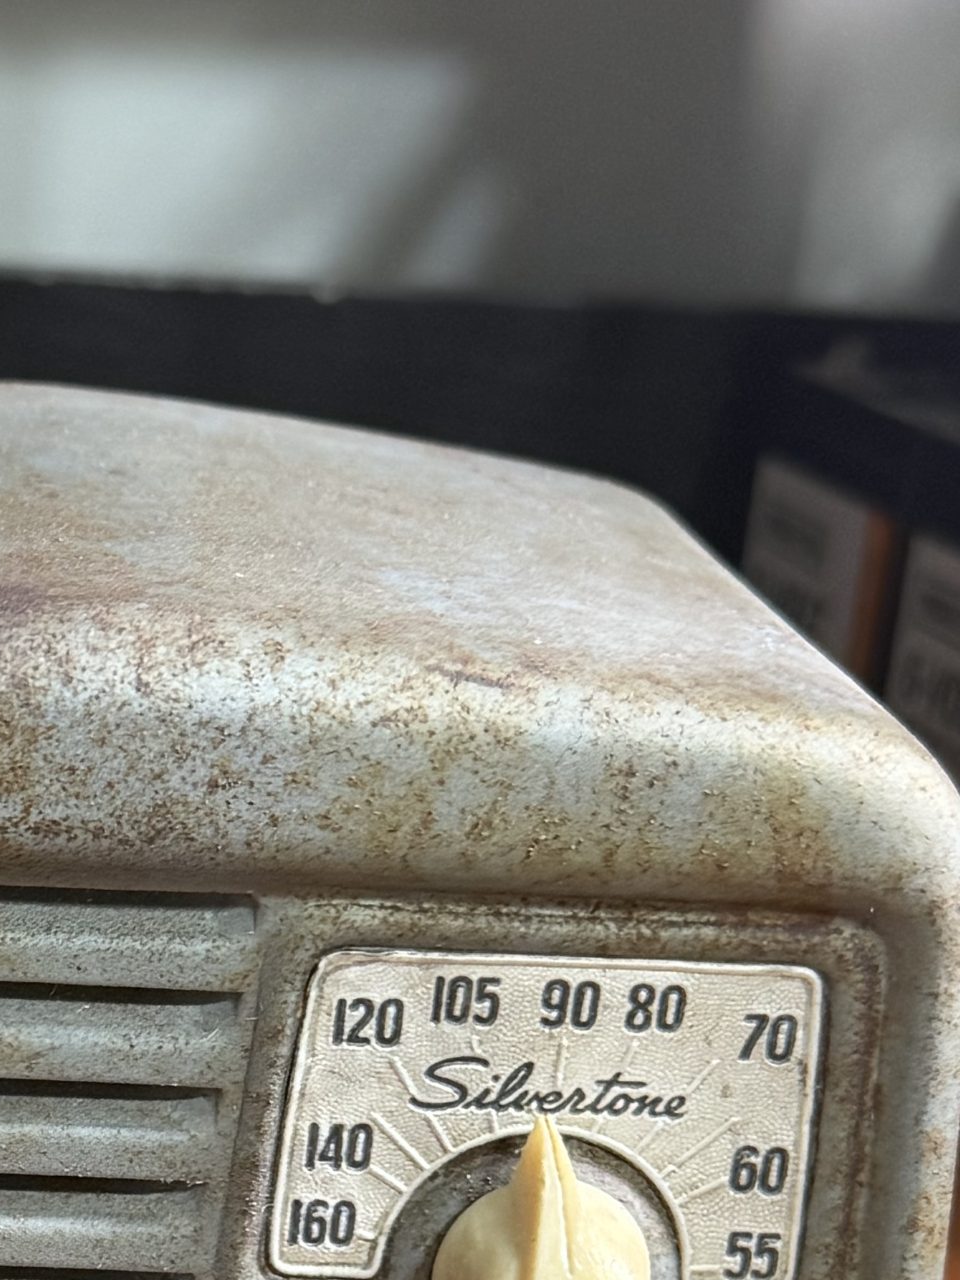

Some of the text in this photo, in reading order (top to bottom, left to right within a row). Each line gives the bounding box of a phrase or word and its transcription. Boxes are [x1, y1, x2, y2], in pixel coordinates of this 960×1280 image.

[332, 998, 404, 1048] 120
[431, 976, 501, 1027] 105
[540, 979, 601, 1030] 90
[625, 984, 687, 1034] 80
[739, 1014, 797, 1064] 70
[410, 1056, 687, 1120] Silvertone
[305, 1123, 373, 1171] 140
[730, 1146, 789, 1196] 60
[288, 1200, 355, 1247] 160
[723, 1233, 781, 1280] 55
